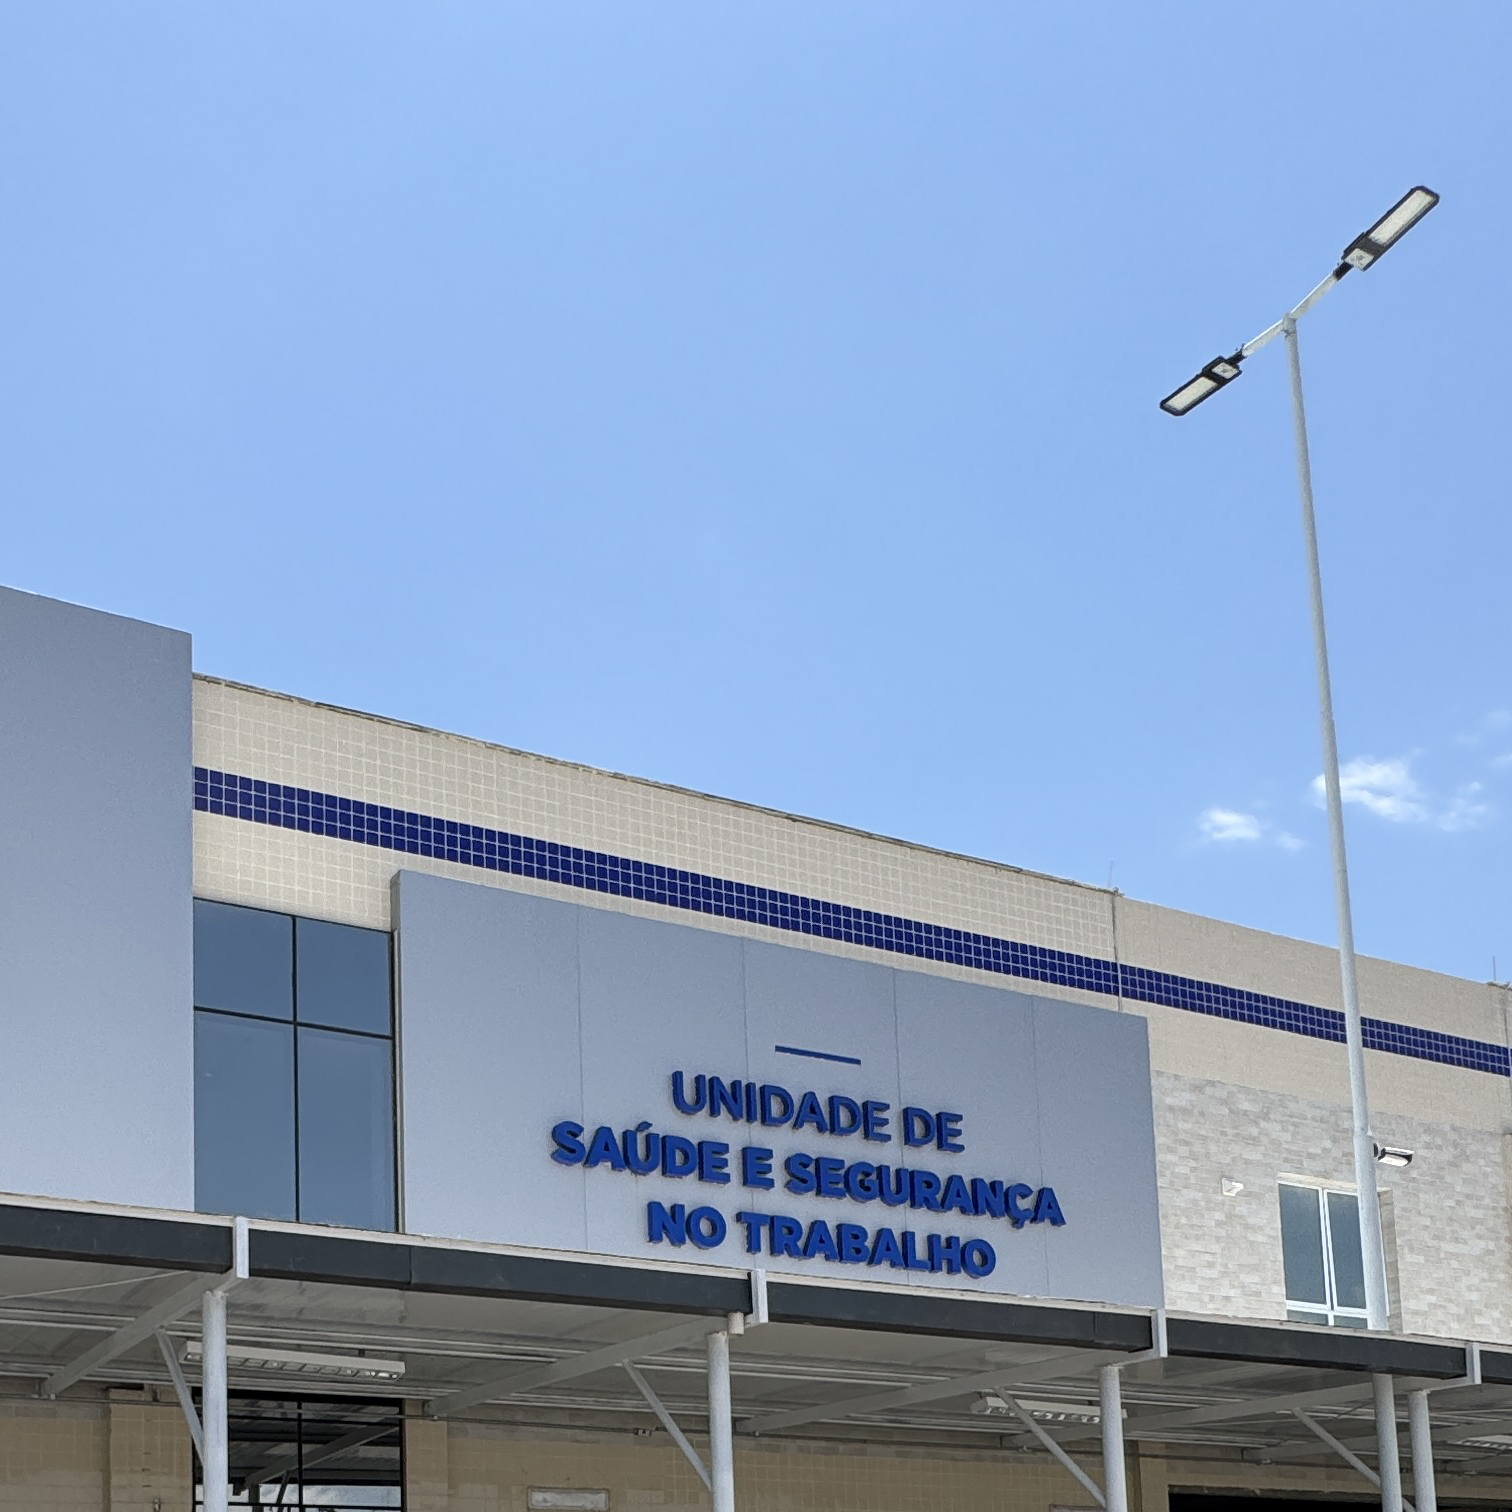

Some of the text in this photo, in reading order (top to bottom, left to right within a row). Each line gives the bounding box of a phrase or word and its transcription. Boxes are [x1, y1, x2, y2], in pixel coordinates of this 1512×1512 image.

[672, 1071, 965, 1153] UNIDADE DE
[551, 1120, 1066, 1228] SAÚDE E SEGURANÇA
[647, 1201, 996, 1278] NO TRABALHO
